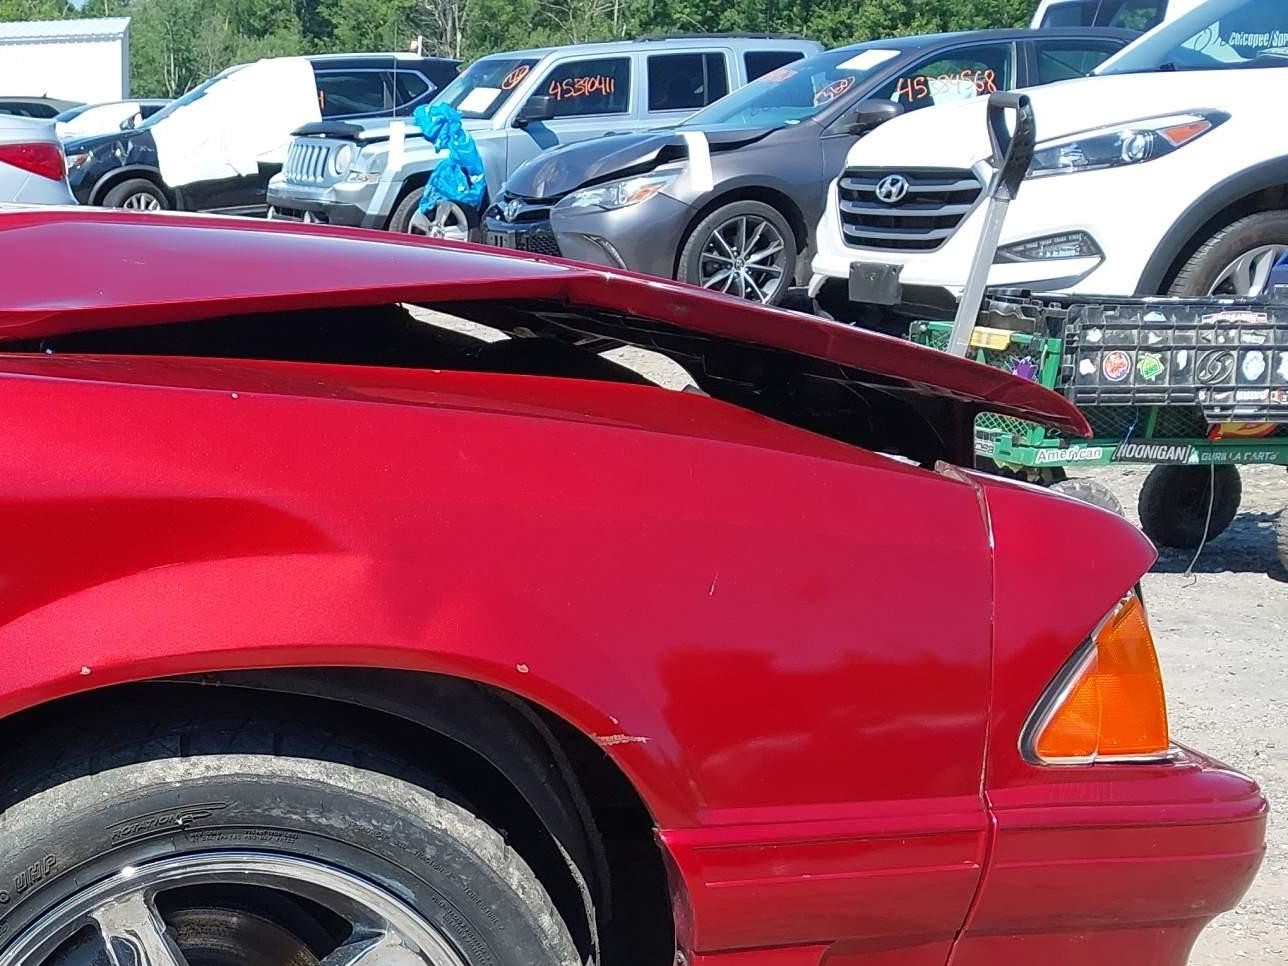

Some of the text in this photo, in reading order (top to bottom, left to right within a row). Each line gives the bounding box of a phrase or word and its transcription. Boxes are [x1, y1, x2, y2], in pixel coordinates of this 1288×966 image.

[548, 74, 615, 101] 45390411
[1035, 447, 1102, 463] American
[14, 853, 58, 894] UHP
